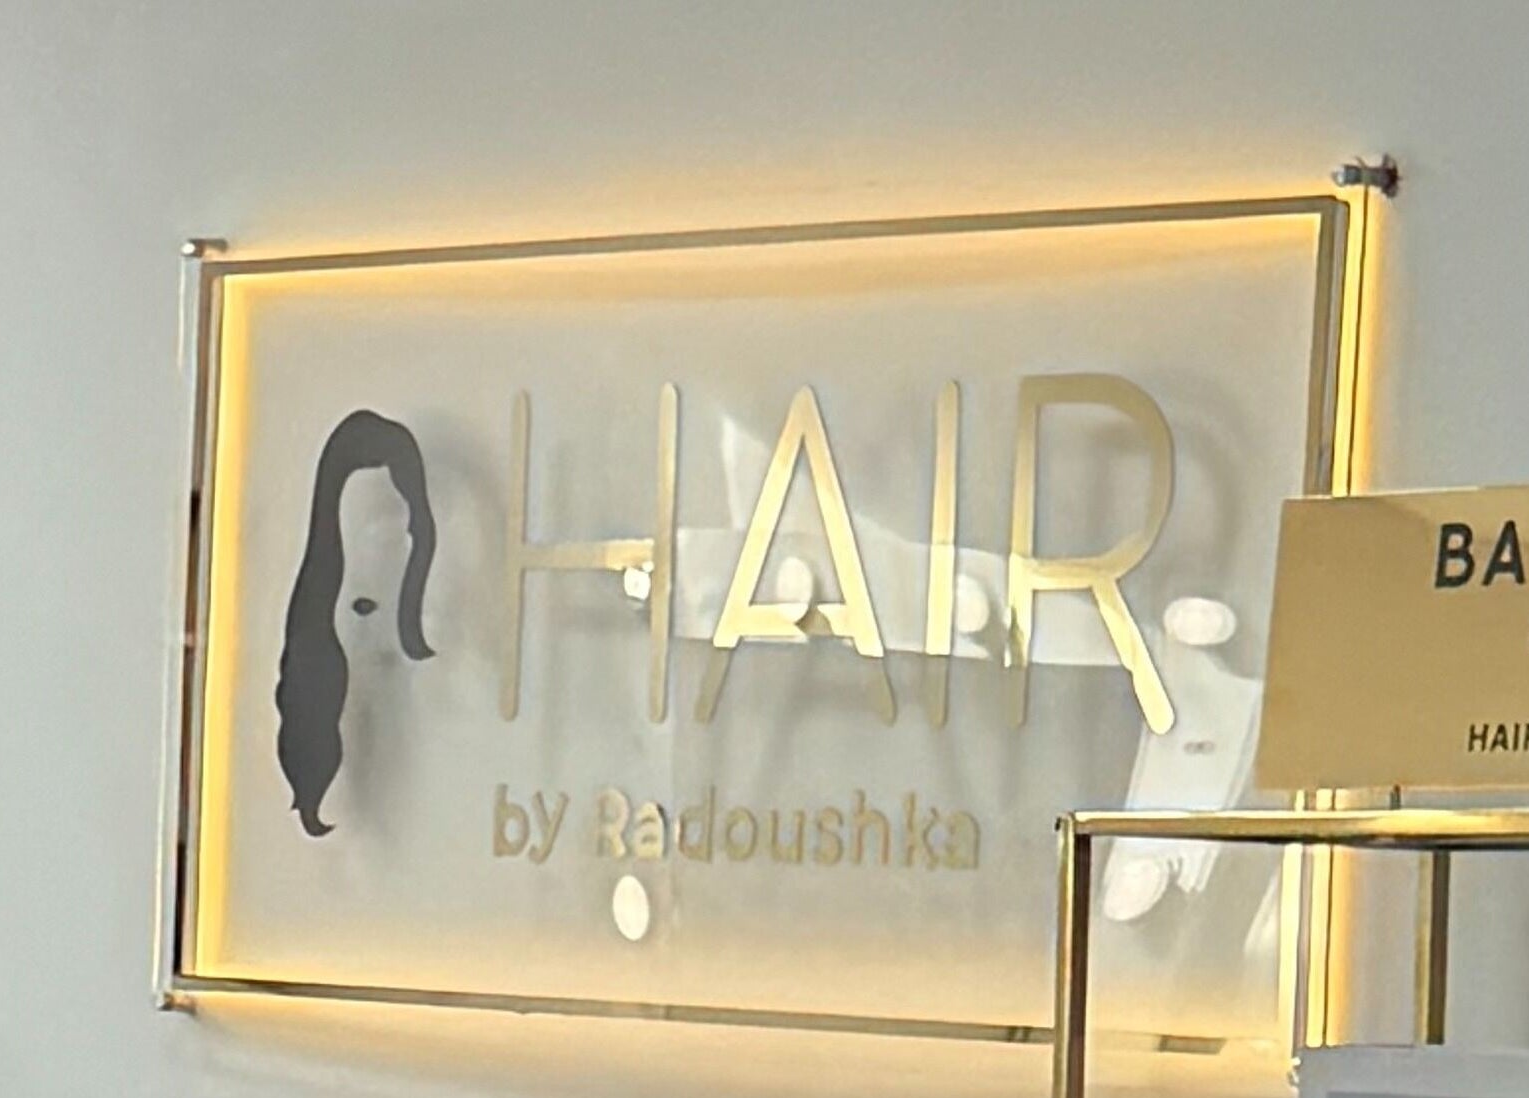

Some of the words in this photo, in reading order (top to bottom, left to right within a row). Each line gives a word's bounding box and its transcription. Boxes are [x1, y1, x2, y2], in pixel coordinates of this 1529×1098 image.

[498, 372, 1177, 736] HAIR
[1434, 519, 1527, 588] BA
[491, 783, 570, 865] by
[596, 783, 981, 871] Radoushka
